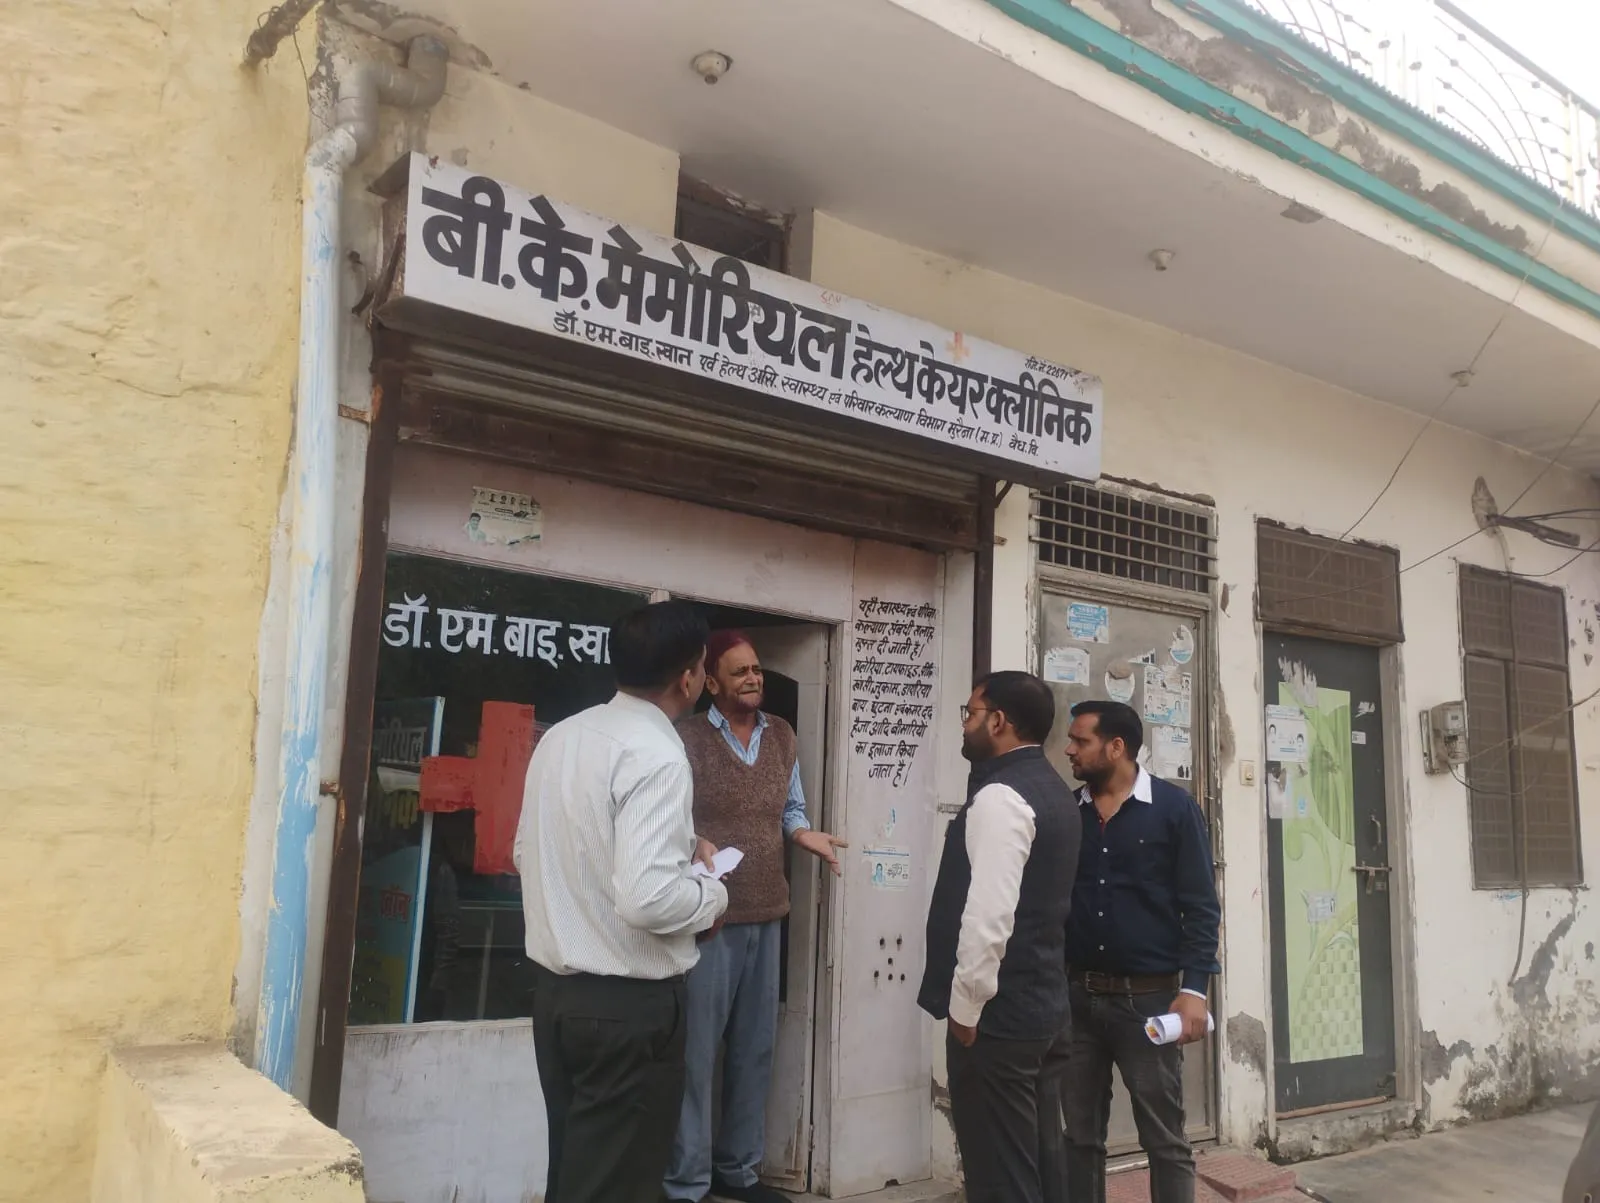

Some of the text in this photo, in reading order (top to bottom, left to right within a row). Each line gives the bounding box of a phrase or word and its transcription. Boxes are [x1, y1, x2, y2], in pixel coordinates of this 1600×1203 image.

[986, 371, 1093, 446] क्लीनिक
[916, 408, 948, 432] विभाग
[569, 623, 611, 664] खा
[877, 636, 887, 653] दी
[887, 637, 912, 656] जाती
[869, 717, 890, 737] आदि
[855, 740, 919, 760] का इलाज किया
[869, 763, 895, 779] जाता
